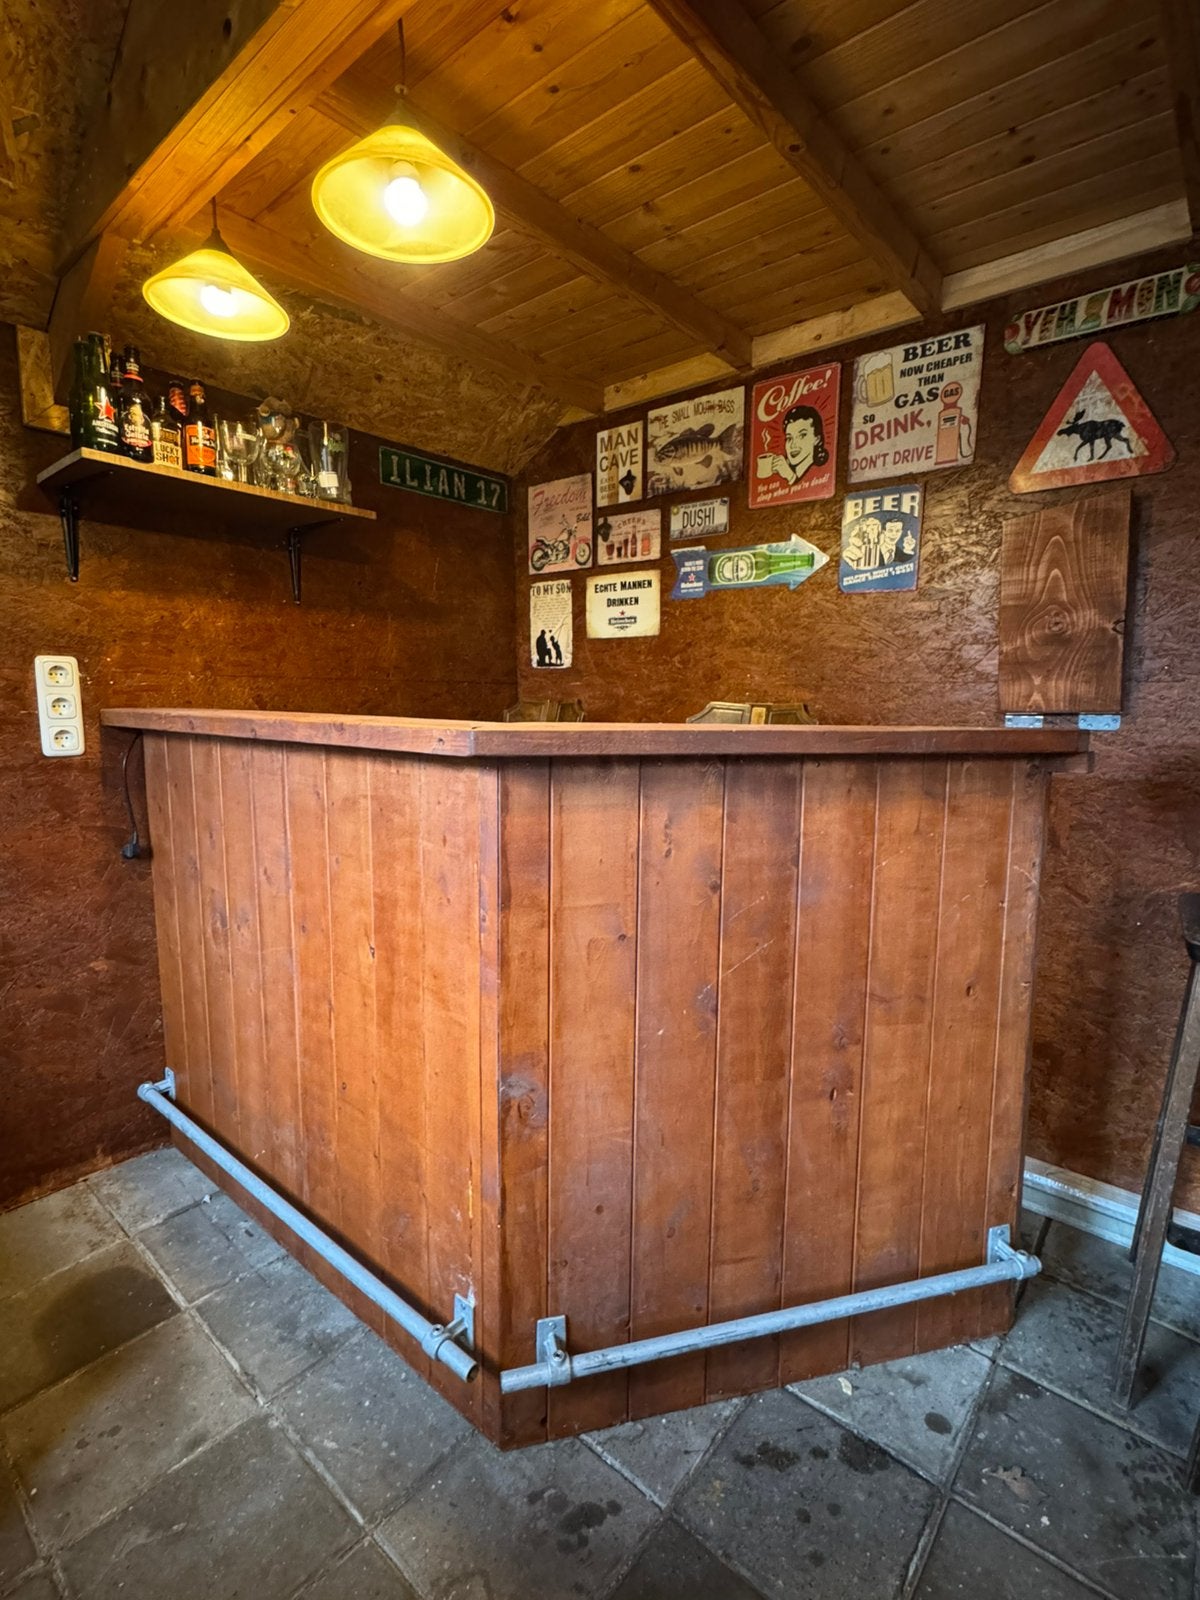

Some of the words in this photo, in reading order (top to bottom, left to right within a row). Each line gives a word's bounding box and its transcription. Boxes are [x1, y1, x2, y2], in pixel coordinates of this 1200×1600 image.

[902, 332, 972, 363] BEER
[900, 365, 924, 378] NOW
[926, 353, 972, 372] CHEAPER
[917, 373, 945, 387] THAN
[757, 369, 832, 422] Coffee!
[894, 387, 940, 409] GAS
[943, 387, 960, 398] GAS
[854, 408, 932, 450] DRINK,
[862, 414, 876, 425] SO
[600, 427, 638, 453] MAN
[600, 448, 638, 472] CAVE
[852, 452, 889, 472] DON'T
[893, 445, 934, 466] DRIVE
[477, 480, 500, 507] 17
[682, 506, 716, 529] DUSHI
[845, 490, 919, 524] BEER
[543, 584, 554, 595] MY
[594, 582, 617, 594] ECHTE
[620, 579, 653, 591] MANNEN
[607, 597, 639, 608] DRINKEN
